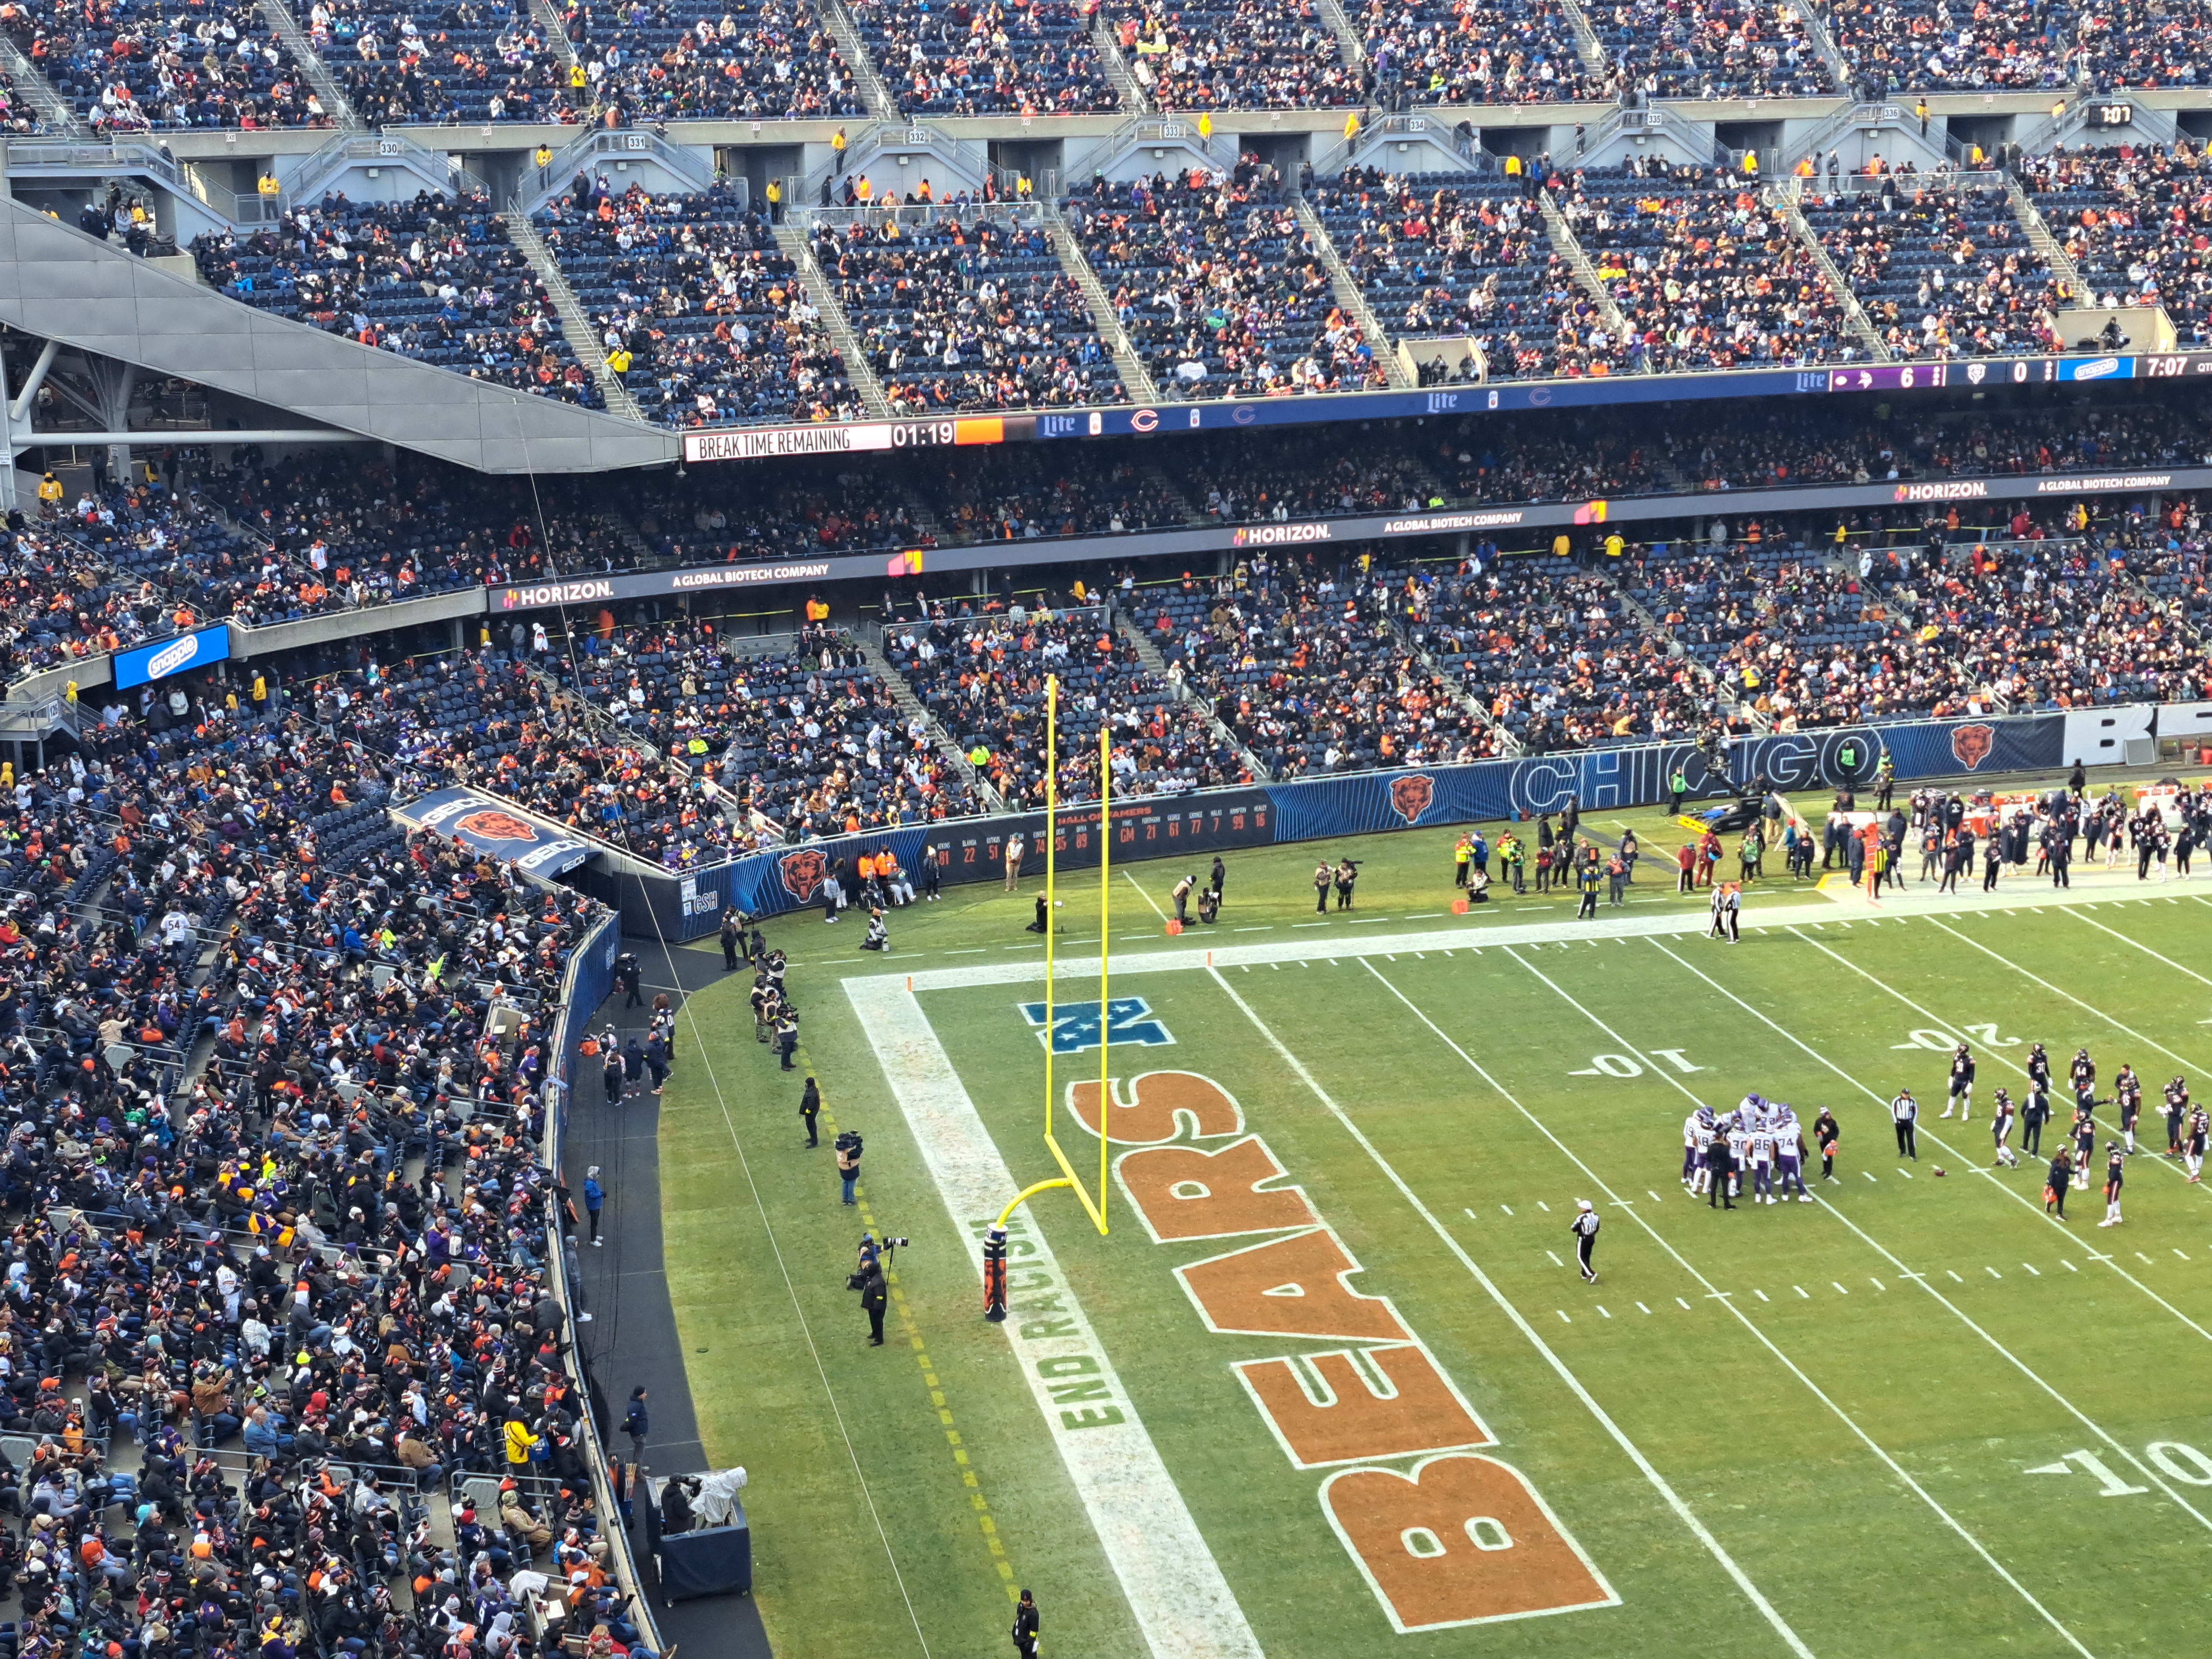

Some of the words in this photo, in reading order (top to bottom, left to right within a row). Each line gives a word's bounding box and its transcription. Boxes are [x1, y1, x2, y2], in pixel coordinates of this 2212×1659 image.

[1648, 115, 1660, 123] 335
[1885, 109, 1897, 117] 336
[2101, 106, 2131, 123] 7:07
[1166, 126, 1178, 136] 333
[1411, 121, 1423, 129] 334
[630, 137, 644, 147] 331
[911, 133, 925, 142] 332
[381, 144, 397, 154] 330
[2014, 362, 2027, 383] 0
[2078, 361, 2115, 377] snapple
[2147, 357, 2188, 376] 7:07
[1795, 371, 1826, 392] Lite
[1900, 367, 1913, 388] 6
[1428, 392, 1457, 413] Lite
[1043, 415, 1075, 437] Lite
[699, 435, 740, 459] BREAK
[743, 432, 775, 455] TIME
[778, 428, 850, 453] REMAINING
[893, 421, 953, 447] 01:19
[2038, 482, 2046, 492] A
[2046, 480, 2081, 491] GLOBAL
[2083, 478, 2123, 489] BIOTECH
[2124, 476, 2170, 487] COMPANY
[1384, 522, 1392, 532] A
[1393, 519, 1429, 532] GLOBAL
[1430, 516, 1472, 529] BIOTECH
[1473, 512, 1522, 526] COMPANY
[673, 575, 681, 587] A
[682, 573, 724, 586] GLOBAL
[725, 568, 772, 583] BIOTECH
[774, 564, 829, 579] COMPANY
[151, 639, 195, 674] snapple
[420, 797, 491, 825] GEICO
[1057, 815, 1087, 825] HALL
[1108, 806, 1152, 818] AMERS
[1169, 821, 1179, 837] 61
[1191, 819, 1202, 834] 77
[1213, 817, 1219, 832] 7
[1232, 814, 1244, 830] 99
[1120, 827, 1135, 843] GM
[1146, 824, 1156, 840] 21
[518, 839, 586, 869] GEICO
[964, 847, 975, 863] 22
[988, 844, 999, 860] 51
[562, 854, 585, 873] GEICO
[694, 891, 717, 915] GSH
[168, 920, 180, 929] 54
[1686, 1125, 1694, 1138] 19
[1698, 1137, 1709, 1147] 18
[1755, 1139, 1770, 1150] 86
[1779, 1138, 1793, 1148] 74
[1065, 1070, 1624, 1634] BEARS
[1036, 1355, 1126, 1430] END
[2062, 1441, 2212, 1497] 10
